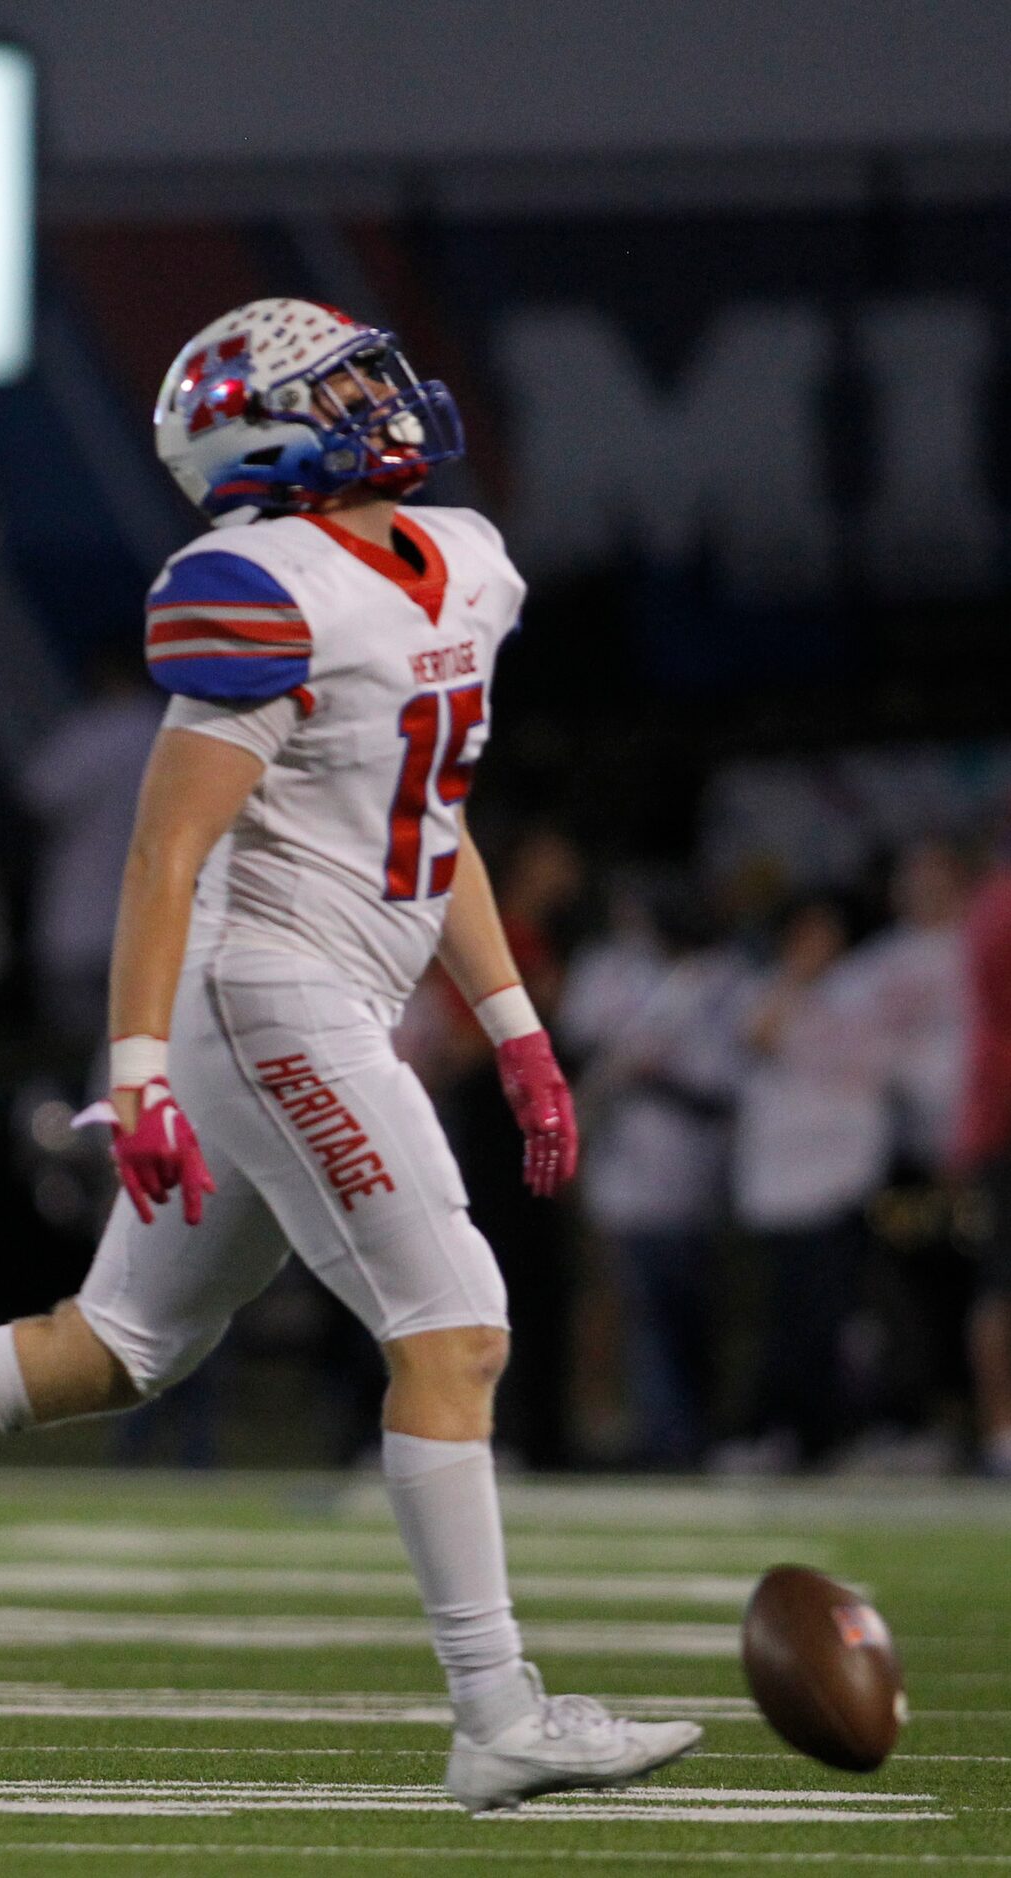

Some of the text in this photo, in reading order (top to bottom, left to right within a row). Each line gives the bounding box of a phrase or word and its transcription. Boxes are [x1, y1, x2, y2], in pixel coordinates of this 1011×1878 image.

[498, 303, 996, 590] MI
[407, 640, 477, 684] HERITAGE
[383, 680, 486, 901] 15
[254, 1053, 396, 1212] HERITAGE
